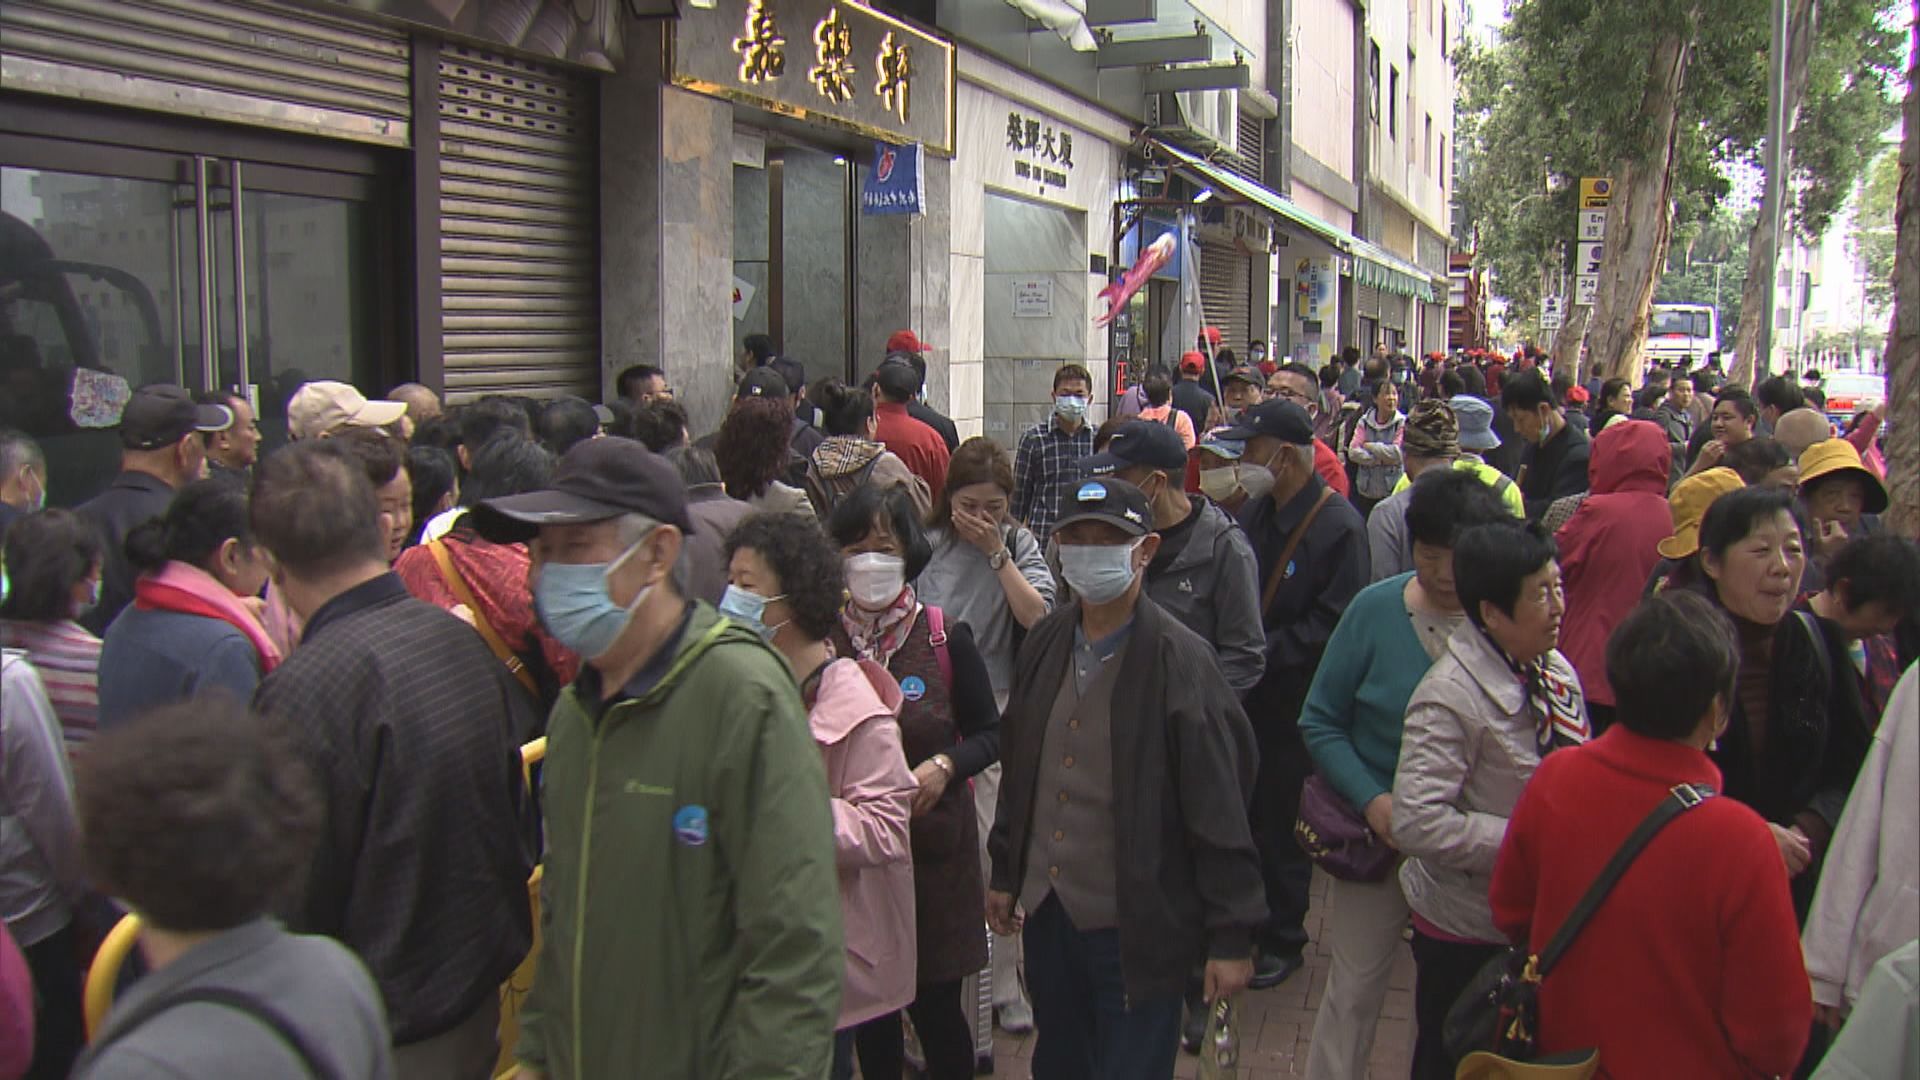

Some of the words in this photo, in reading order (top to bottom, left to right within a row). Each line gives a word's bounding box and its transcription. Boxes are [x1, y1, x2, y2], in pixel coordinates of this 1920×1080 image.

[732, 0, 909, 125] 嘉樂軒
[1590, 214, 1605, 223] En
